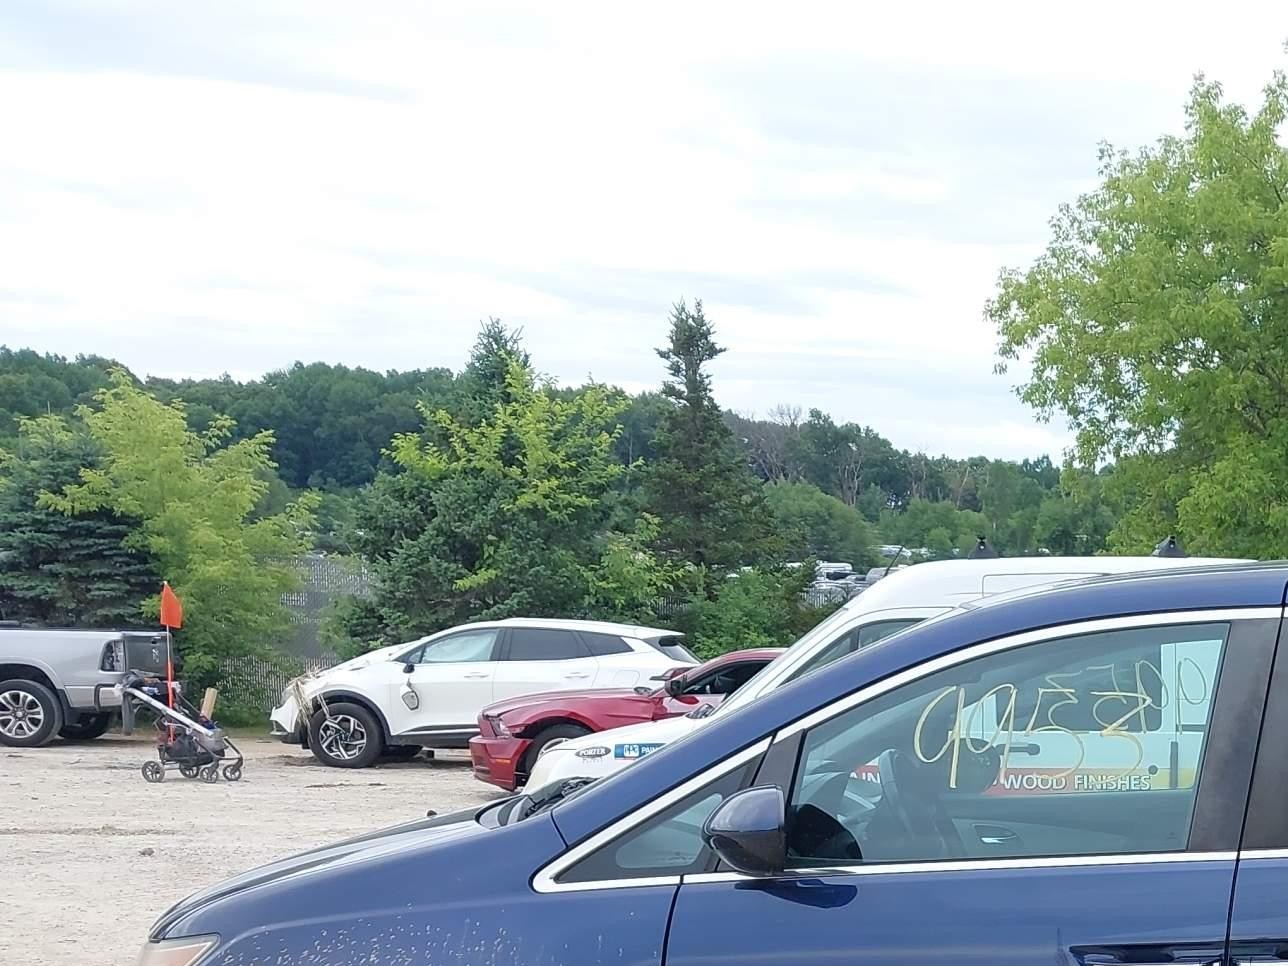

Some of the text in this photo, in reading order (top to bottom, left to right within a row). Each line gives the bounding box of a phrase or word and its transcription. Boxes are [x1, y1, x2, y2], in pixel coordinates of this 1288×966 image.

[579, 747, 606, 757] PORTER
[1004, 774, 1067, 790] WOOD
[1074, 774, 1151, 791] FINISHES
